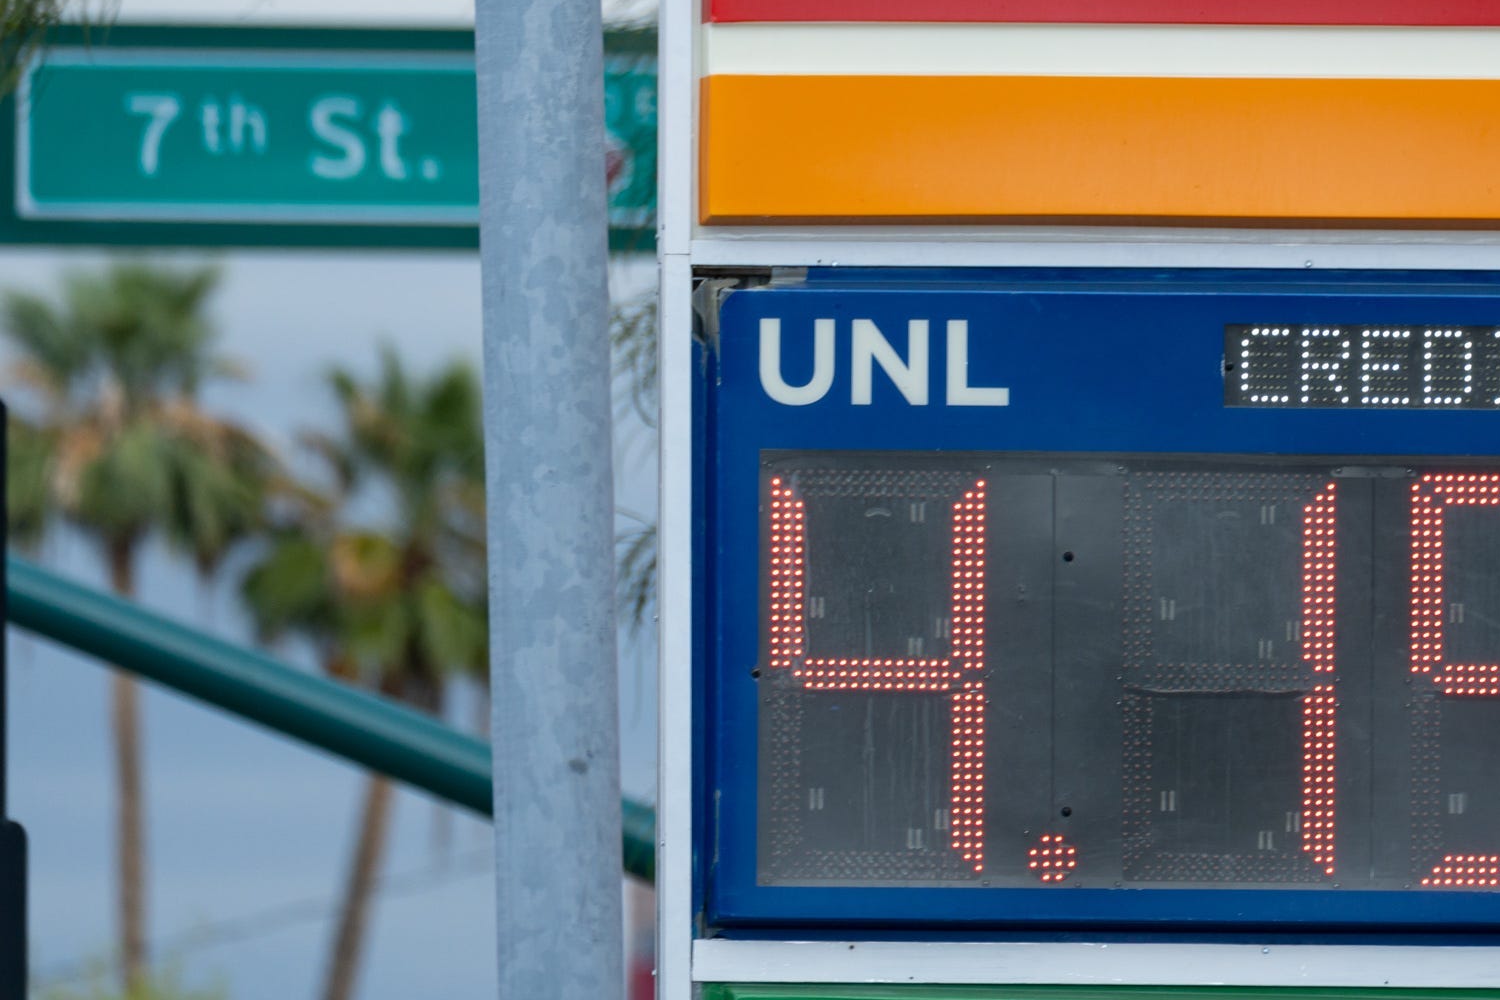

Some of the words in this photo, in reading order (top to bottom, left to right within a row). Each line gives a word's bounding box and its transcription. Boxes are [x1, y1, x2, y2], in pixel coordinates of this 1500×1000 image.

[128, 96, 267, 175] 7th
[310, 99, 439, 179] St.
[757, 316, 1010, 407] UNL
